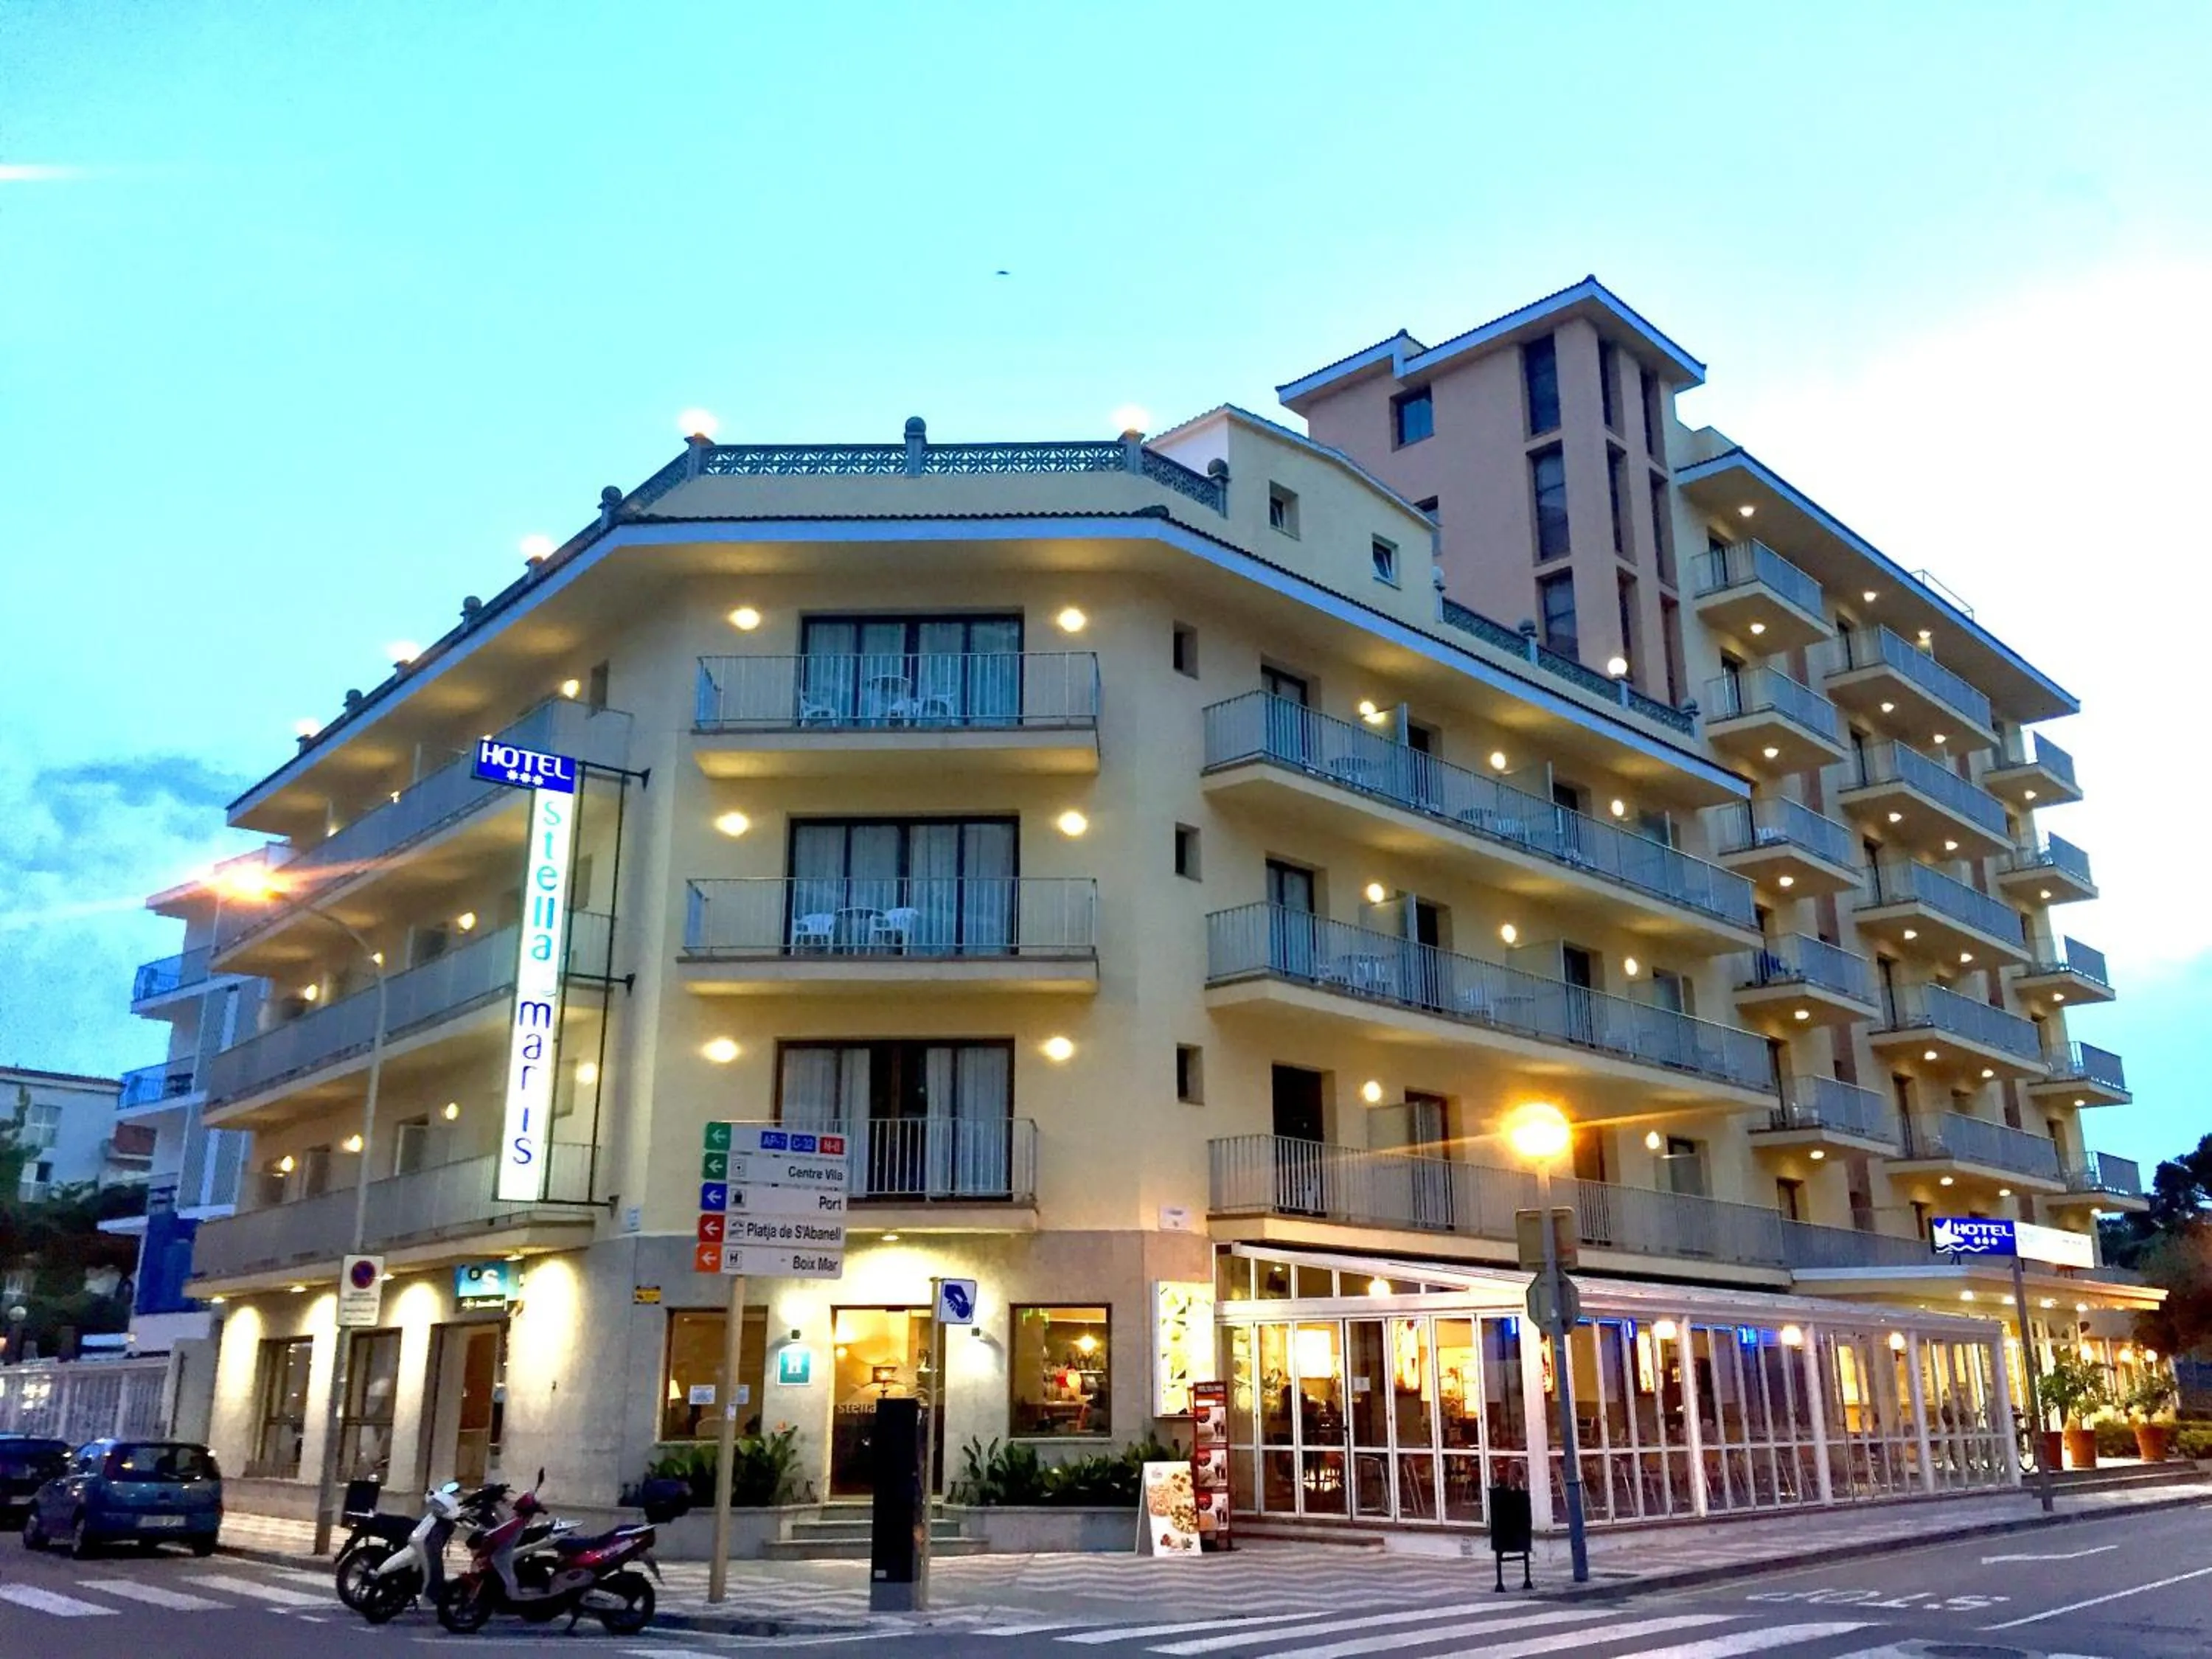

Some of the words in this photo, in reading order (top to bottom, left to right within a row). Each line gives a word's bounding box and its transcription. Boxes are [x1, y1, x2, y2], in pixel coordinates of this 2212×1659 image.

[481, 742, 571, 780] HOTEL
[531, 801, 562, 961] stella
[512, 1001, 552, 1165] maris
[788, 1166, 823, 1179] Centre
[826, 1168, 843, 1180] Vila
[819, 1196, 841, 1210] Port
[747, 1222, 776, 1240] Platja
[779, 1225, 793, 1239] de
[795, 1225, 841, 1240] S'Abanell
[1954, 1223, 2014, 1237] HOTEL
[793, 1255, 815, 1270] Boix
[818, 1257, 838, 1271] Mar
